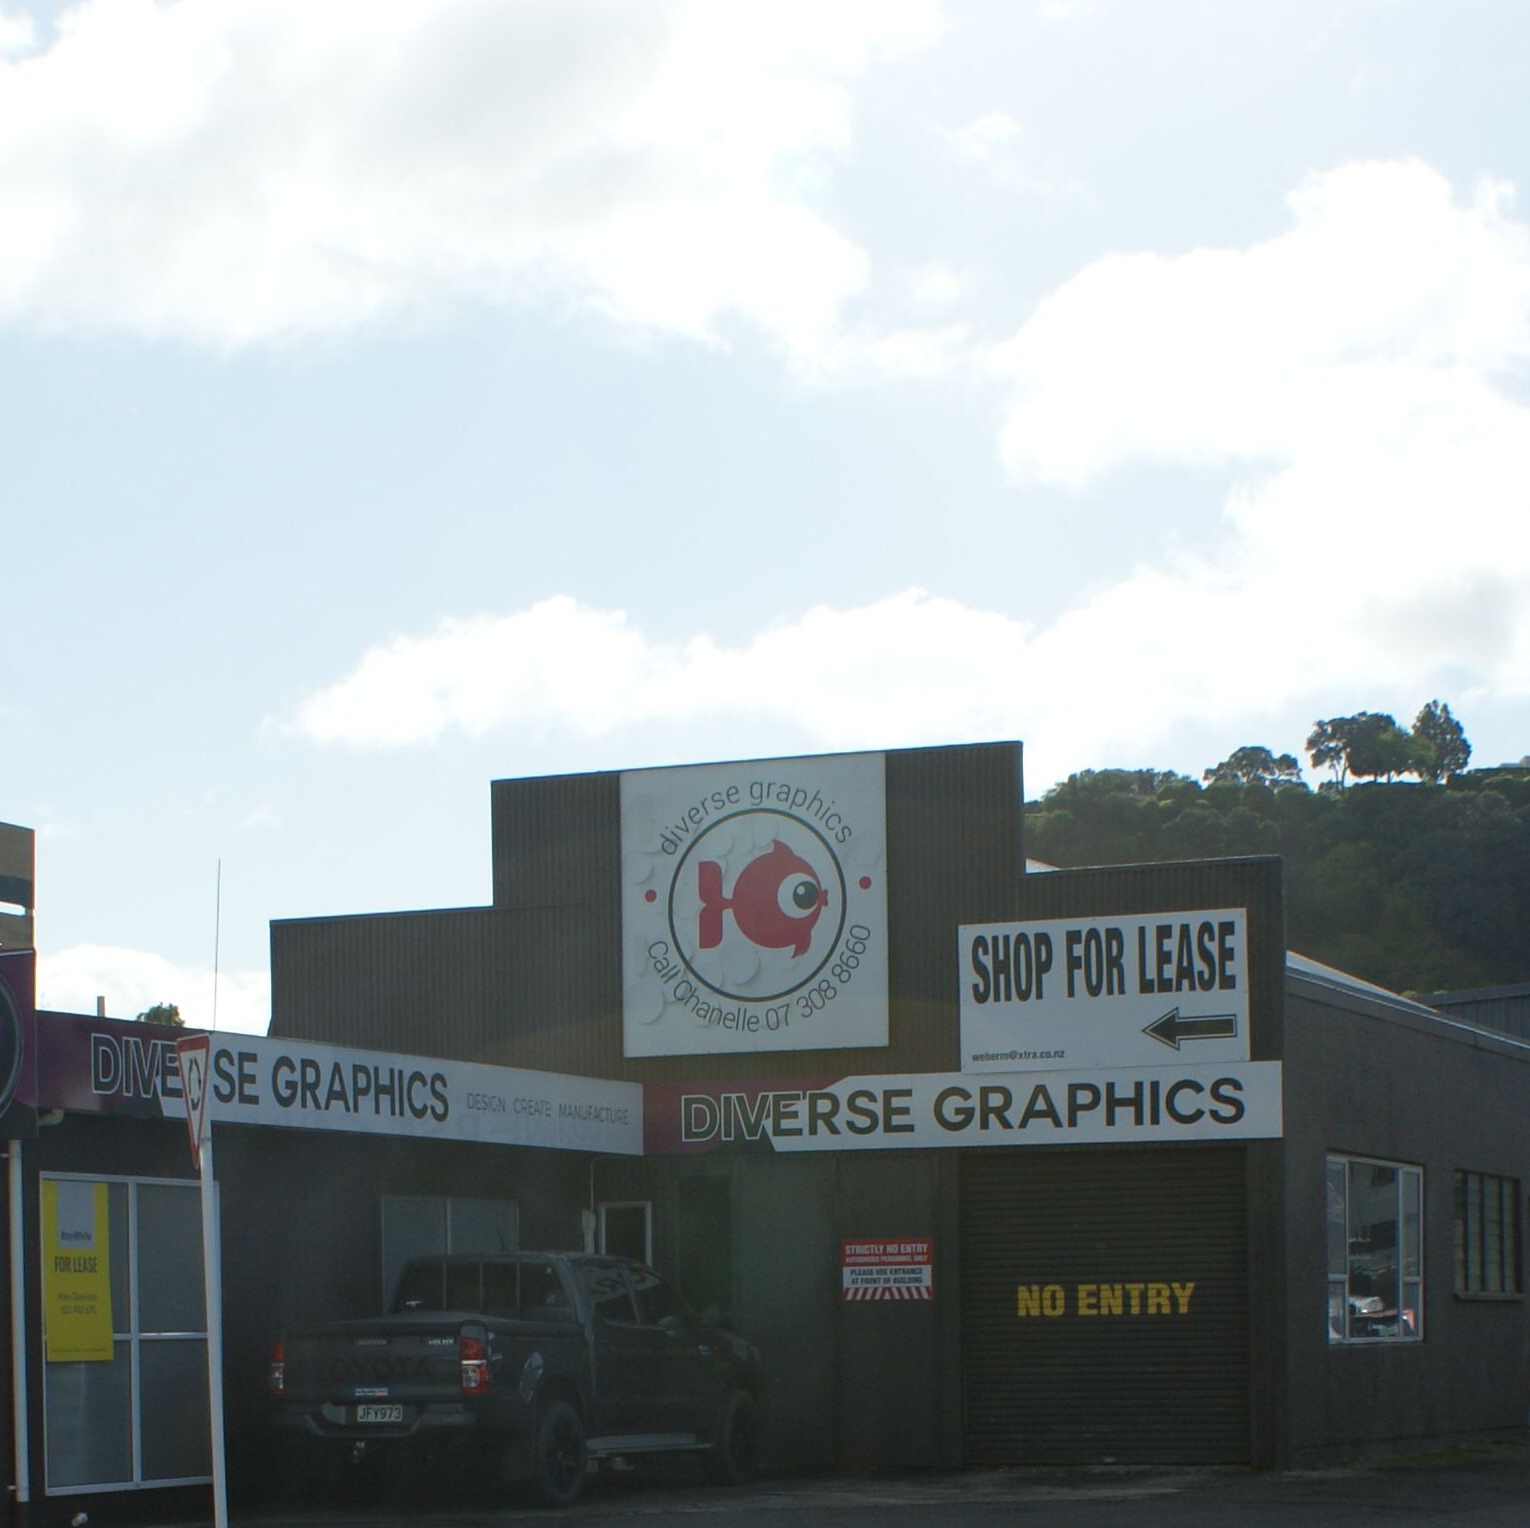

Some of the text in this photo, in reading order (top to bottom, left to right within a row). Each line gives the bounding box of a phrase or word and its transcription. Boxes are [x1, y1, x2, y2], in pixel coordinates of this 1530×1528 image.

[661, 781, 852, 856] diverse graphics
[648, 924, 871, 1033] Call Chanelle 07 308 8660
[971, 920, 1237, 1004] SHOP FOR LEASE
[90, 1032, 450, 1123] DIVESE GRAPHICS
[467, 1092, 629, 1126] DESIGN CREATE MANUFACTURE
[680, 1077, 1246, 1143] DIVERSE GRAPHICS
[54, 1256, 98, 1273] FOR LEASE
[845, 1243, 928, 1255] STRICTLY NO ENTRY
[1017, 1282, 1196, 1317] NO ENTRY
[358, 1406, 403, 1421] JFY973
